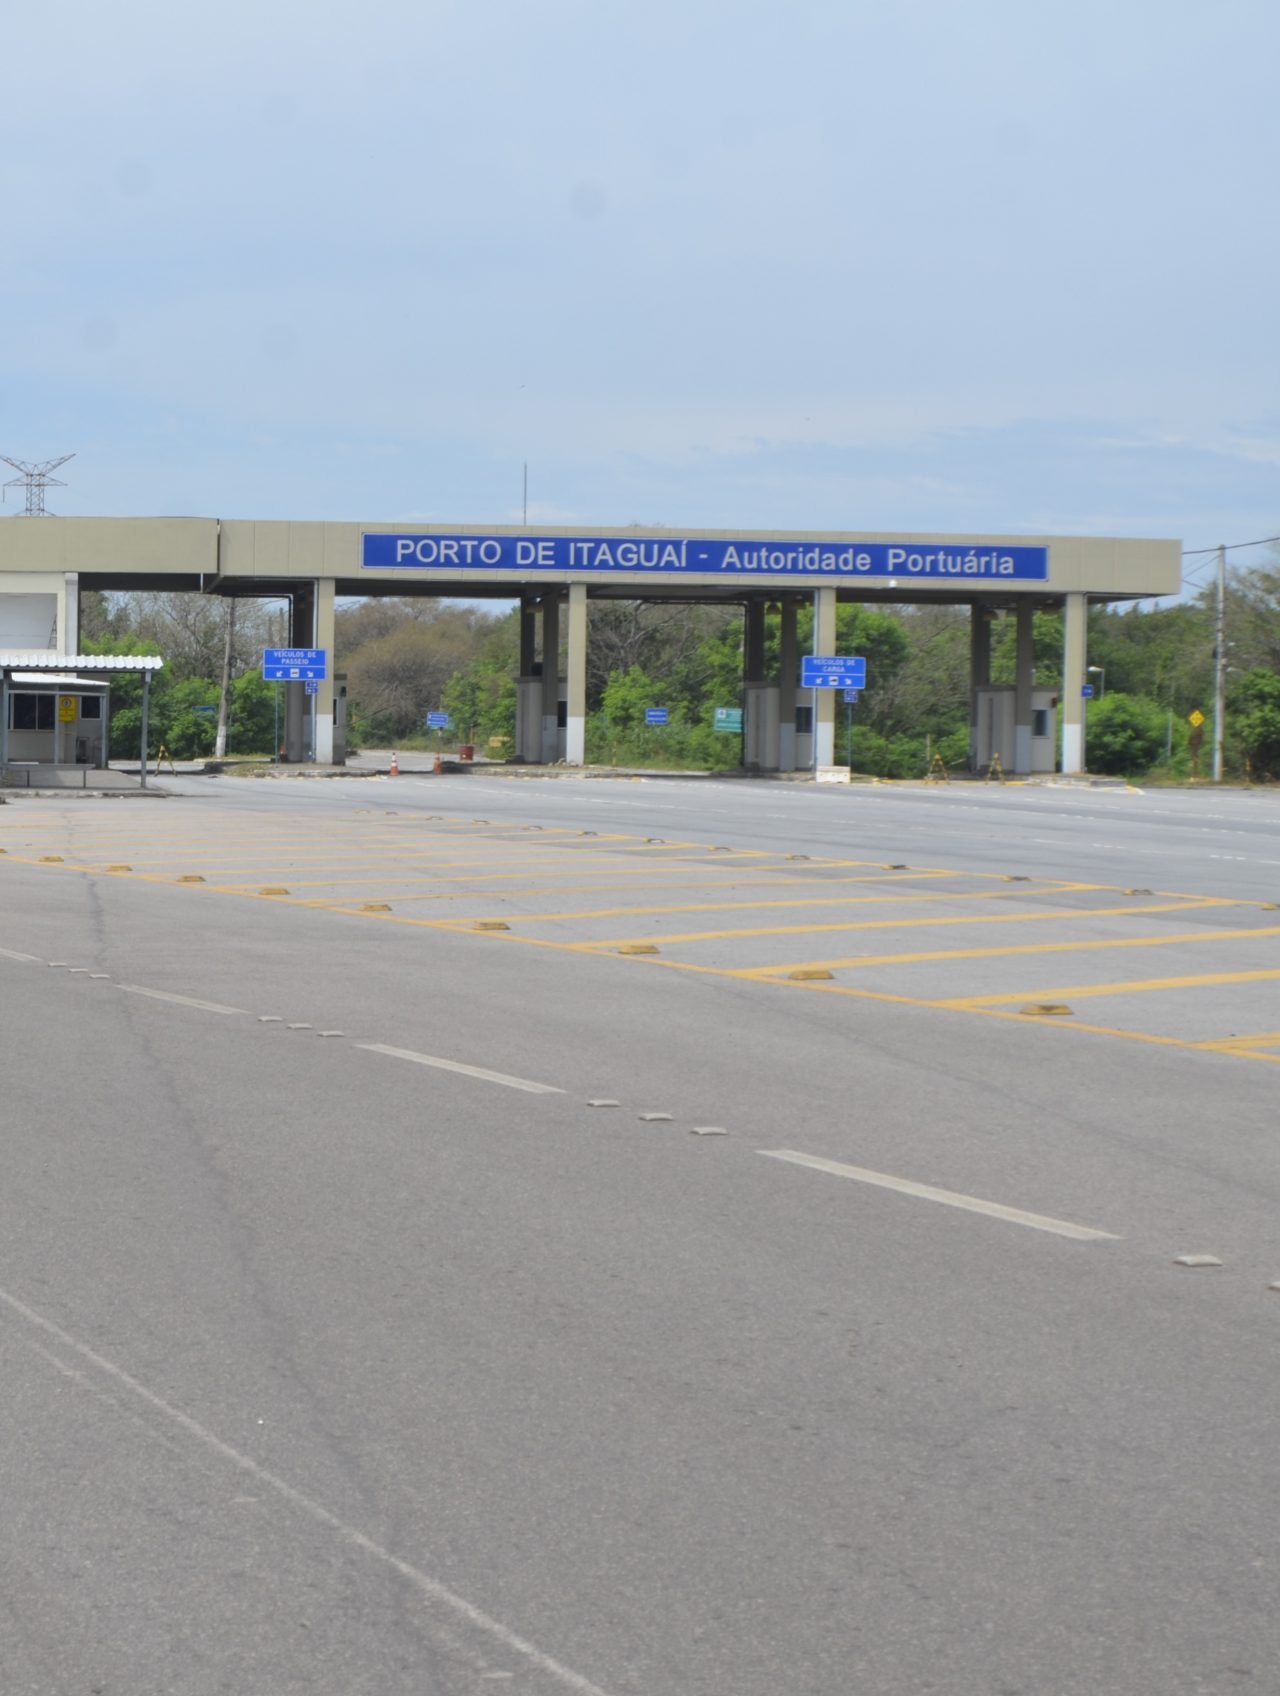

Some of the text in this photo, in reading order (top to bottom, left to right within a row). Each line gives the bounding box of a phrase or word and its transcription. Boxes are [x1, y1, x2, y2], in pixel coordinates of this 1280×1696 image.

[396, 539, 502, 564] PORTO
[516, 542, 556, 565] DE
[569, 539, 688, 567] ITAGUAÍ
[721, 545, 872, 571] Autoridade
[887, 548, 1015, 574] Portuária
